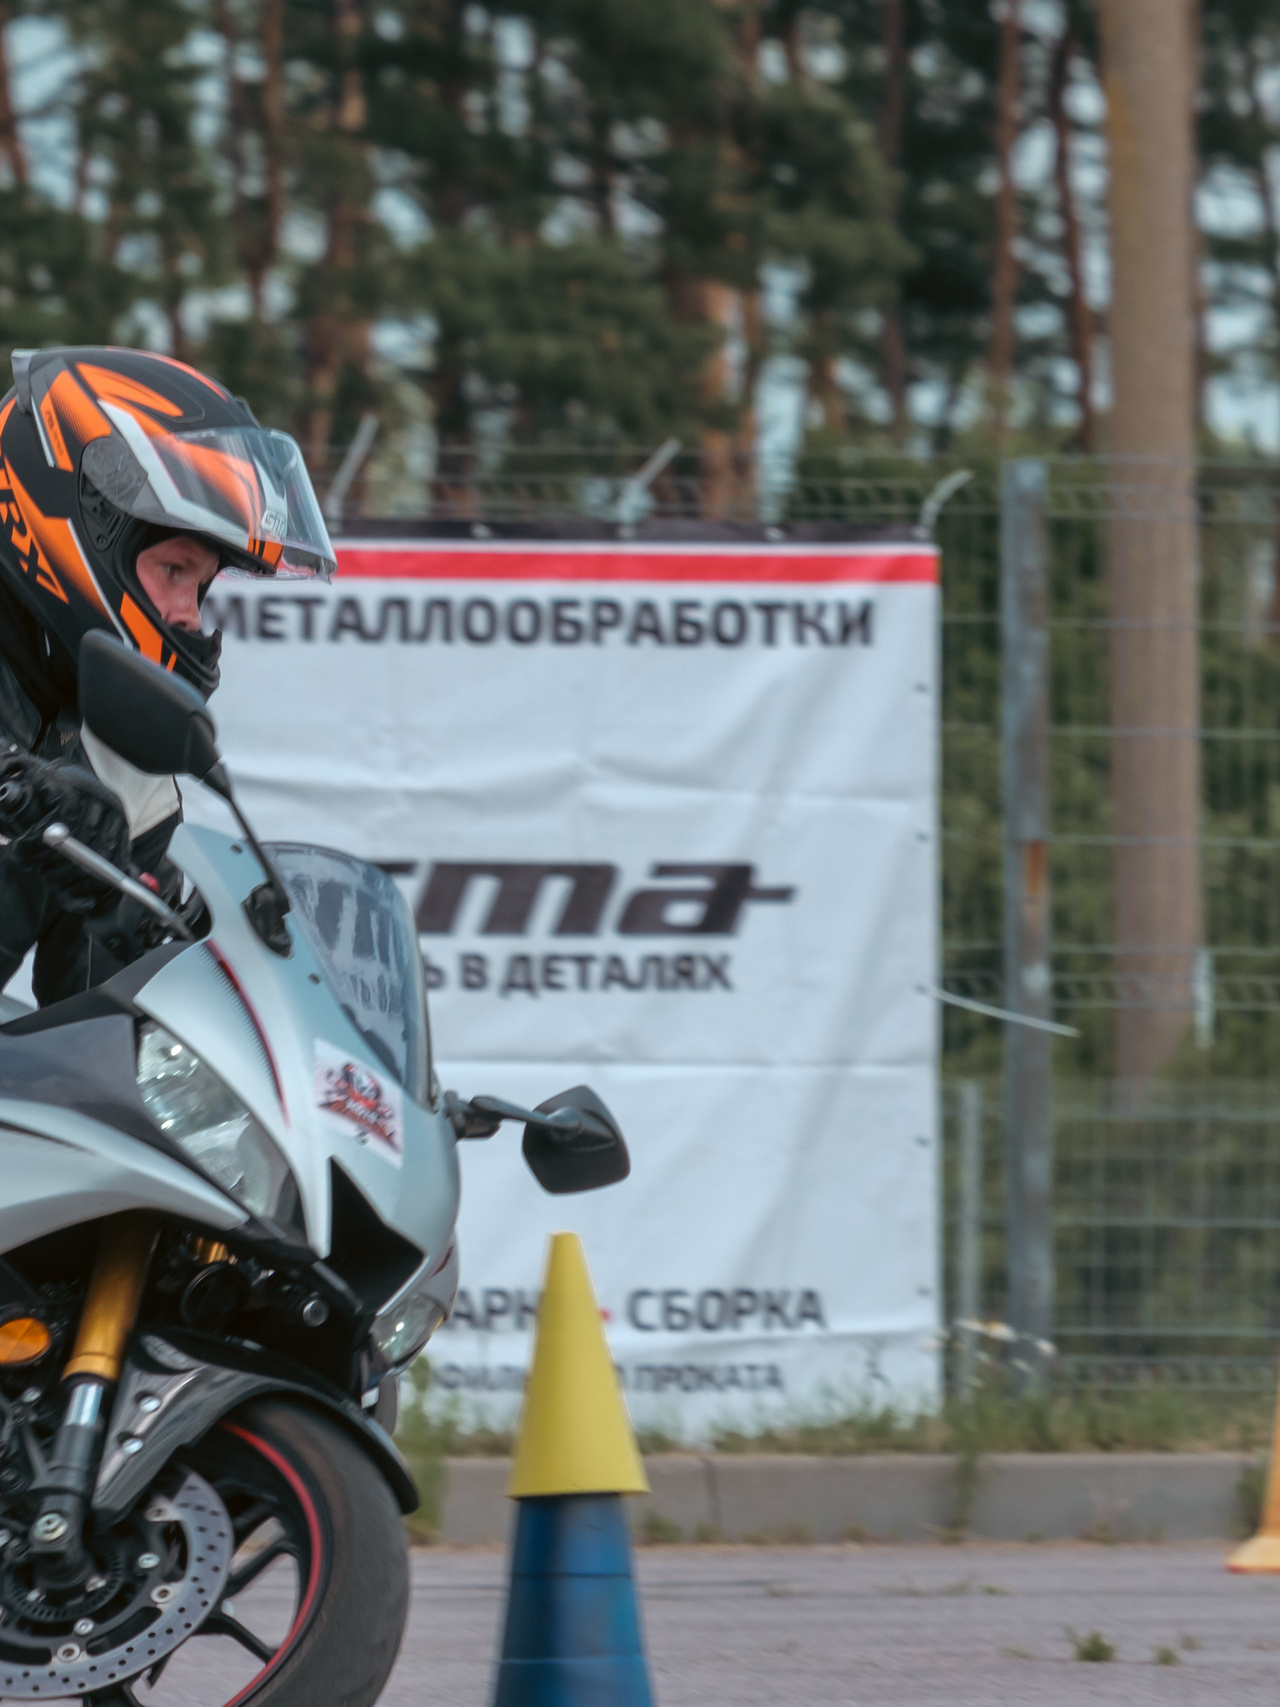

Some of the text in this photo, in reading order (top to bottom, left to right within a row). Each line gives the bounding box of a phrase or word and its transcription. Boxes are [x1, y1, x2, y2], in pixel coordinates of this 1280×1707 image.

[204, 593, 876, 648] МЕТАЛЛООБРАБОТКИ
[459, 953, 490, 991] В
[499, 953, 736, 999] ДЕТАЛЯХ
[626, 1286, 828, 1333] СБОРКА
